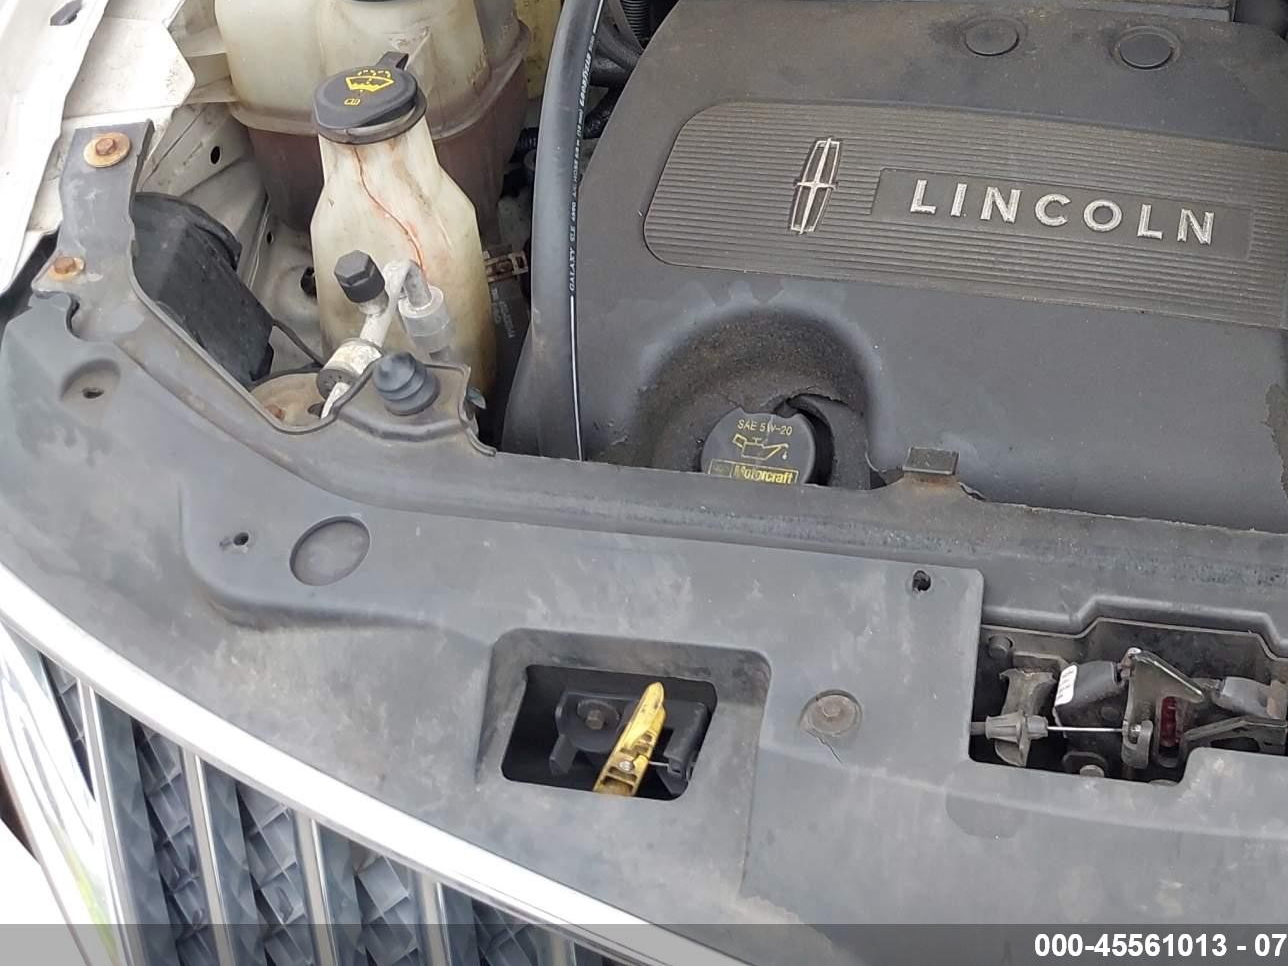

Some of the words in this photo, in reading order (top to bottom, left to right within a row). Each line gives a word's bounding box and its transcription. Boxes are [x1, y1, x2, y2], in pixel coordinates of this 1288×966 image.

[909, 179, 1216, 246] LINCOLN
[737, 419, 758, 431] SAE
[760, 422, 793, 436] 5W-20
[735, 464, 793, 484] Motorcraft
